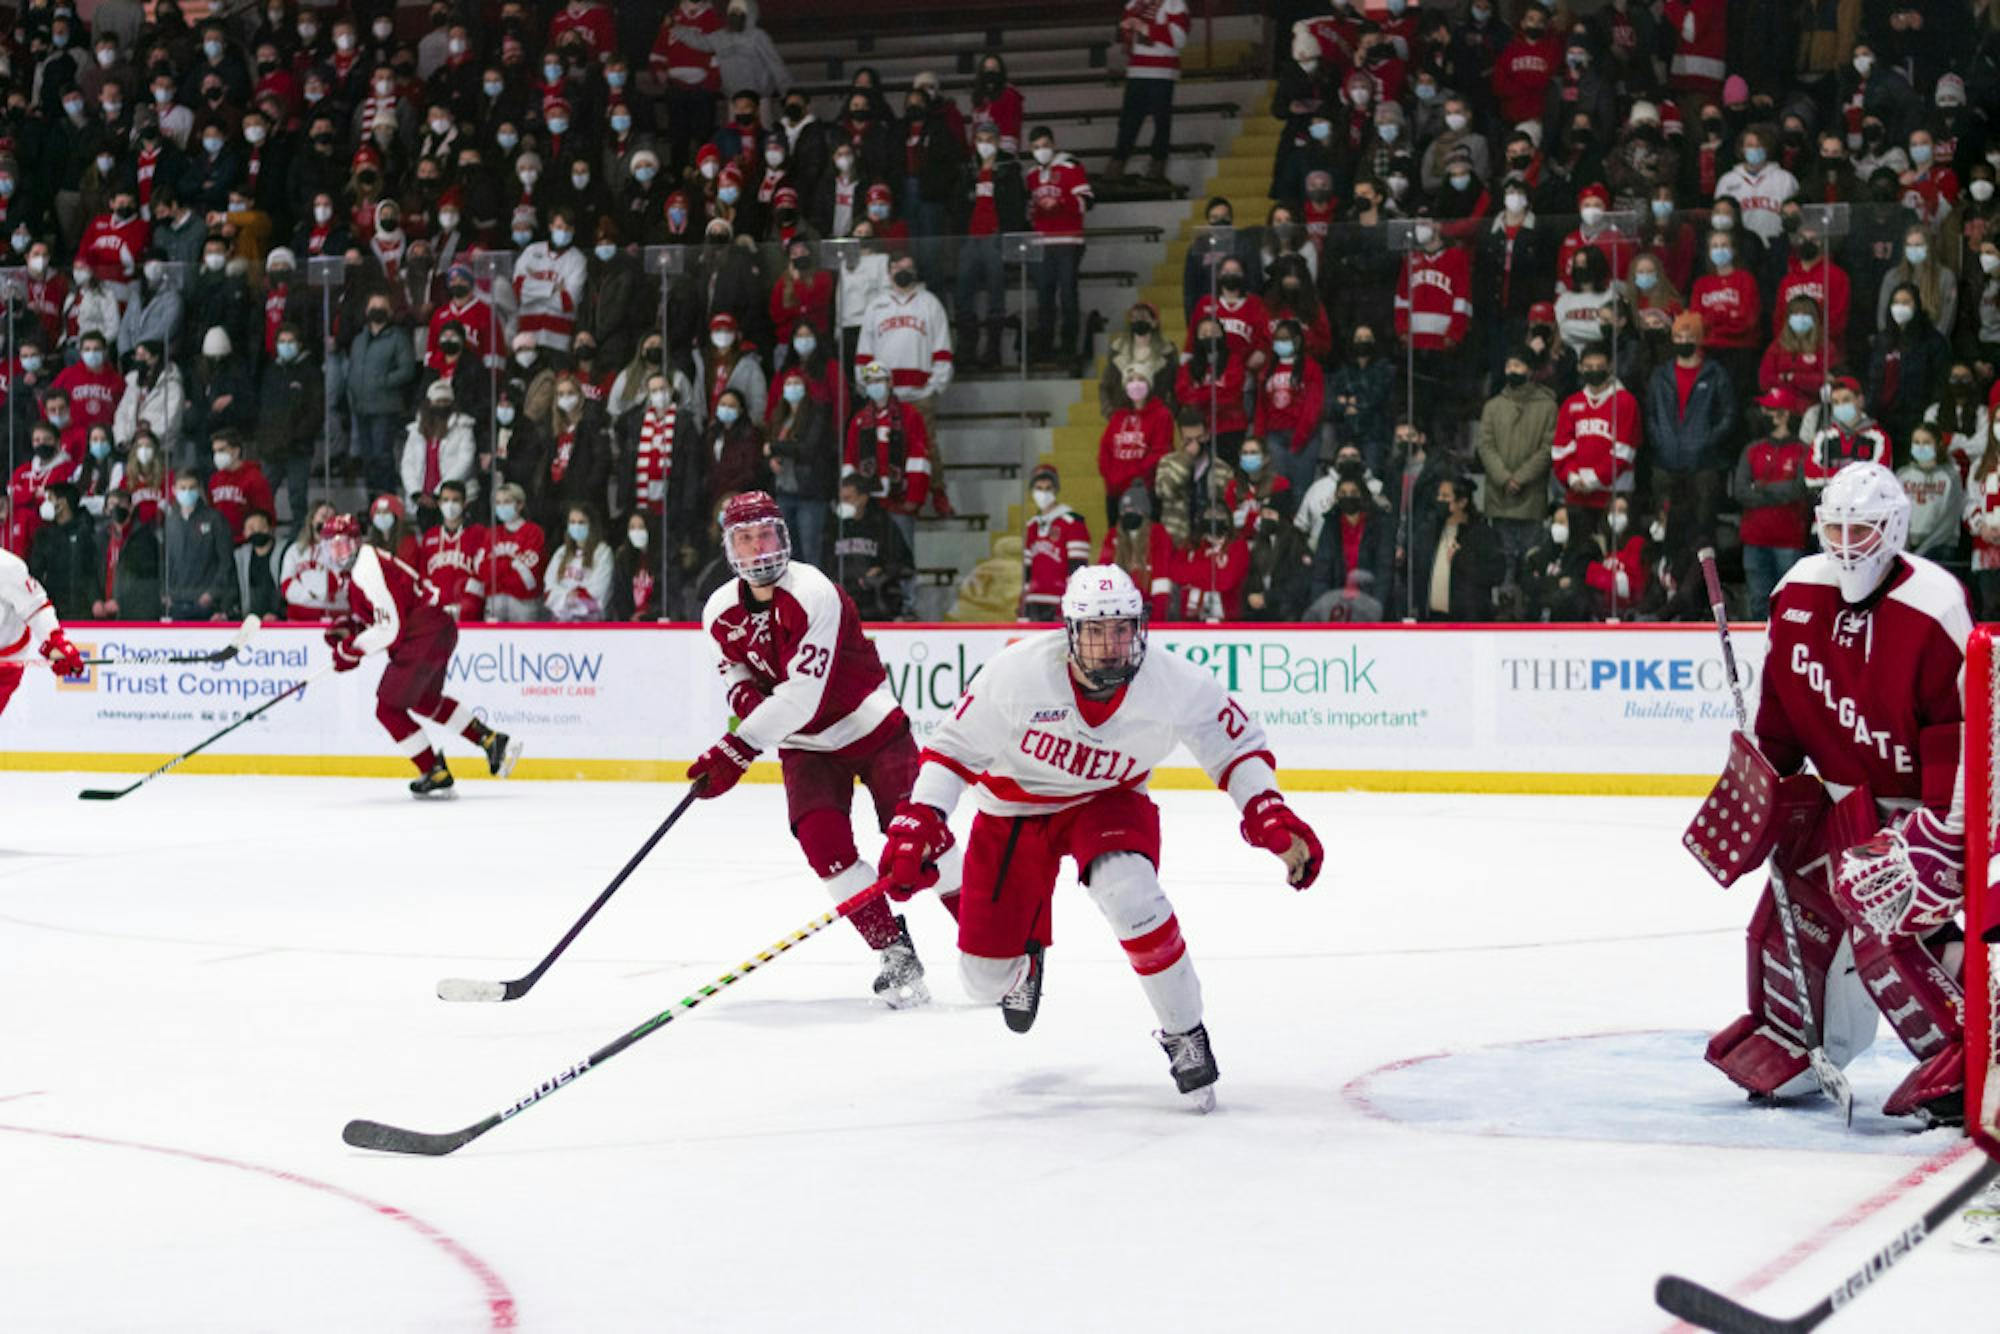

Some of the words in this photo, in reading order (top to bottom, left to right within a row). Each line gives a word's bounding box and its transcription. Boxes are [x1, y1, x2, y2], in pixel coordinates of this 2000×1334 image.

[1099, 579, 1113, 591] 21
[234, 643, 308, 667] Canal
[796, 643, 830, 679] 23
[1260, 643, 1378, 694] Bank
[102, 672, 168, 696] Trust
[177, 672, 308, 701] Company
[521, 686, 563, 697] URGENT
[567, 686, 597, 697] CARE
[492, 712, 582, 725] WellNow.com
[1217, 697, 1249, 740] 21
[1264, 708, 1323, 726] what's
[1623, 700, 1694, 723] Building
[1791, 642, 1914, 774] COLGATE
[1020, 728, 1137, 782] CORNELL
